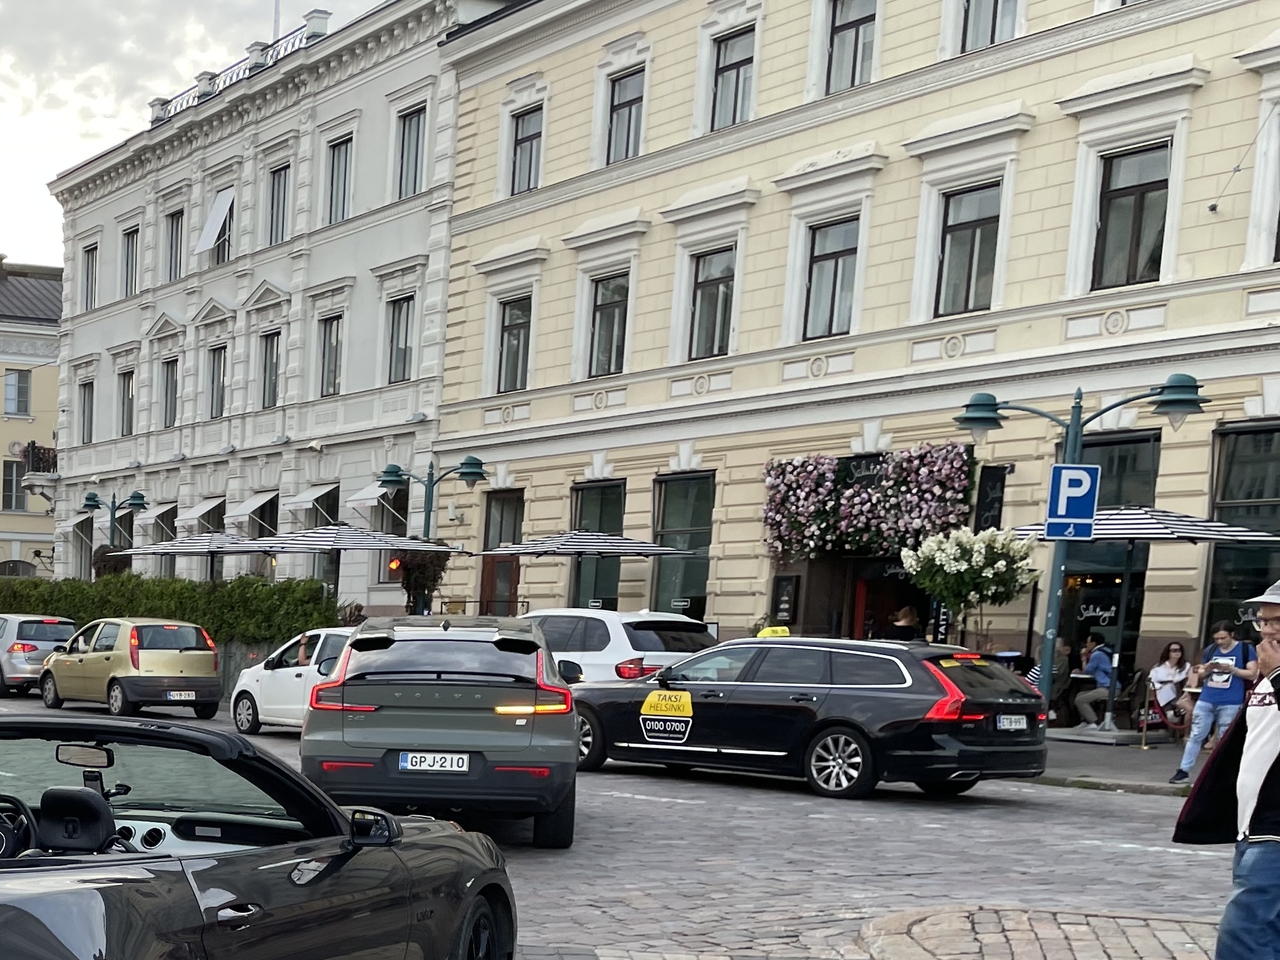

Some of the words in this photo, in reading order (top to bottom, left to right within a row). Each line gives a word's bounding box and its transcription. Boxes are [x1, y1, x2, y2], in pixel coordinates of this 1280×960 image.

[1057, 469, 1092, 516] P
[657, 694, 682, 702] TAKSI
[649, 703, 685, 712] HELSINKI
[646, 721, 664, 730] 0100
[666, 722, 686, 731] 0700
